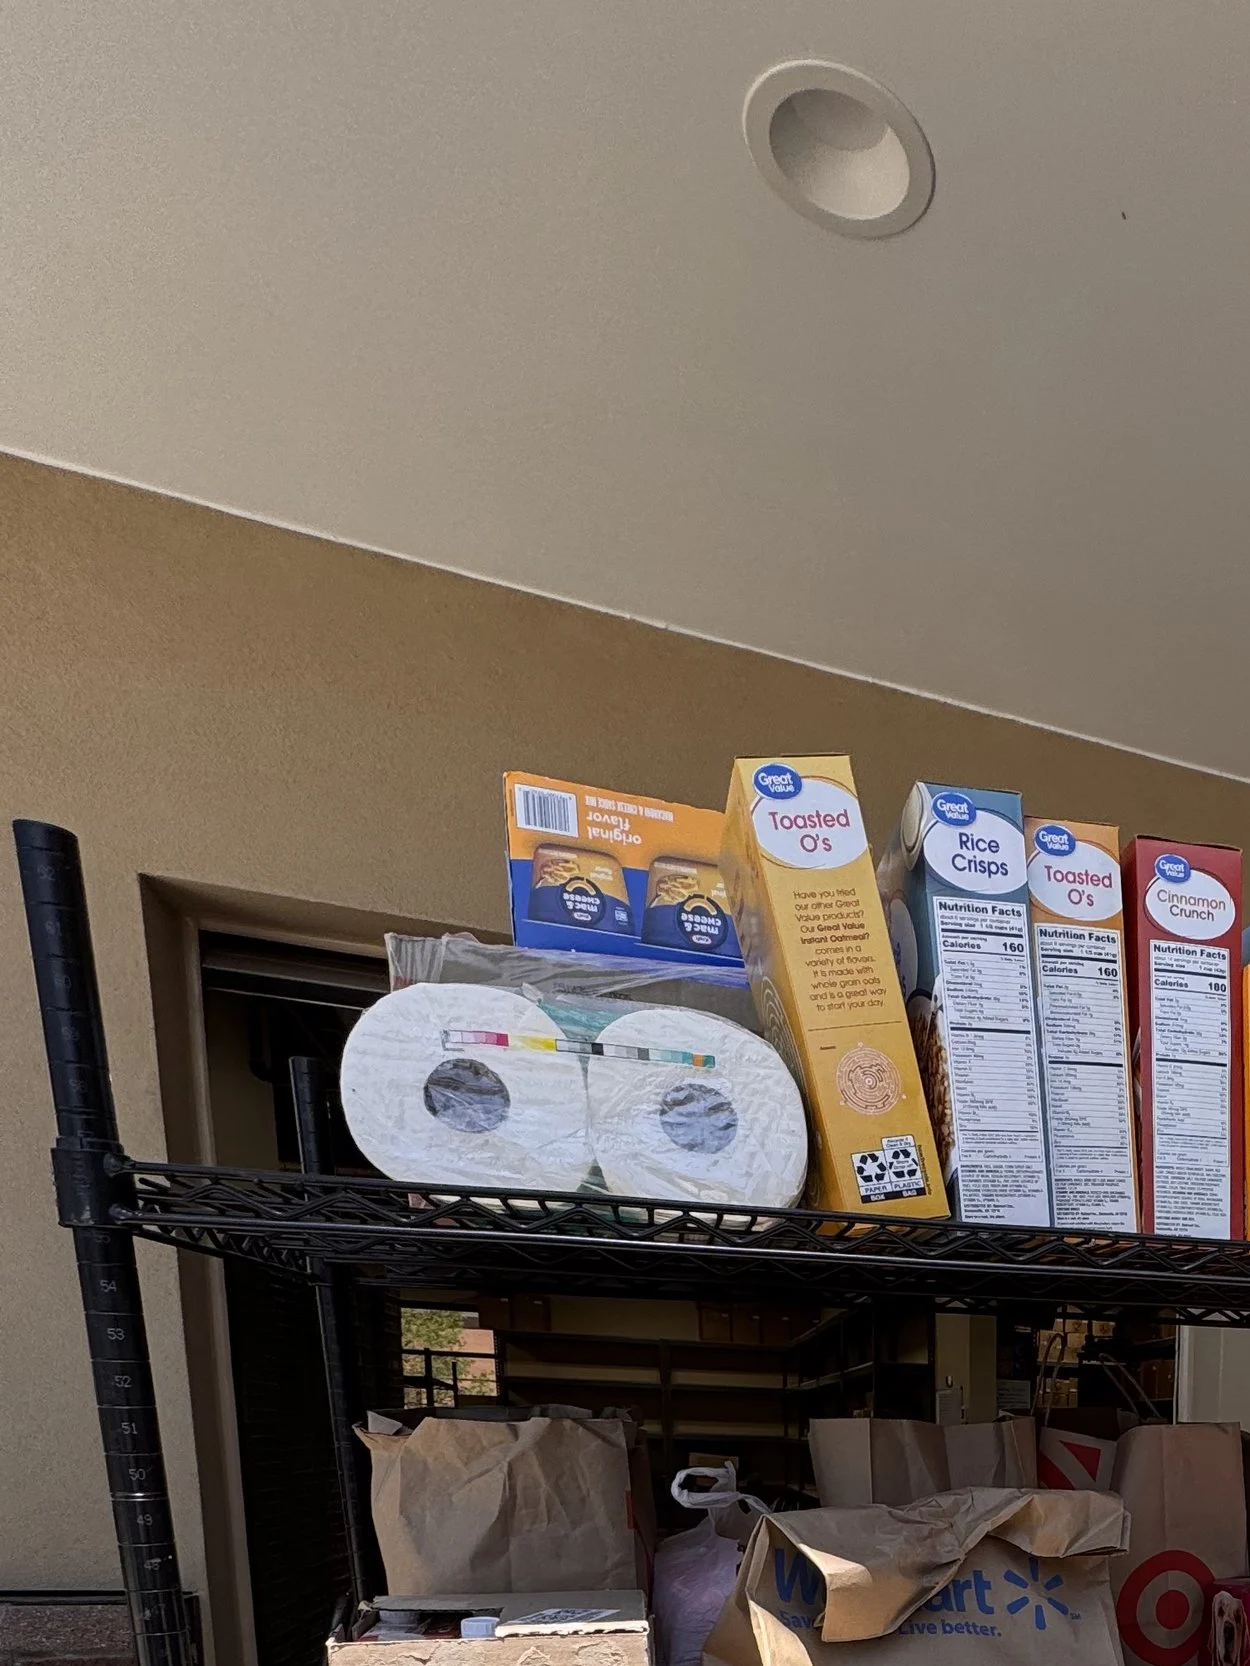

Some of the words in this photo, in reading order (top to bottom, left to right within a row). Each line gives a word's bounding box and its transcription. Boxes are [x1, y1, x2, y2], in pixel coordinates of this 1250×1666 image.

[758, 772, 793, 785] Great
[768, 783, 795, 793] Value
[937, 799, 969, 813] Great
[586, 812, 630, 831] flavor
[768, 808, 851, 831] Toasted
[945, 810, 969, 820] Value
[589, 826, 641, 845] original
[959, 832, 1000, 853] Rice
[1039, 830, 1069, 844] Great
[800, 833, 832, 853] O's
[1046, 842, 1070, 851] Value
[951, 854, 1009, 879] Crisps
[1159, 860, 1185, 872] Great
[1044, 865, 1113, 888] Toasted
[1068, 888, 1094, 907] O's
[1157, 889, 1226, 911] Cinnamon
[938, 901, 988, 915] Nutrition
[991, 905, 1022, 918] Facts
[1169, 904, 1215, 921] Crunch
[696, 922, 719, 935] mac
[1039, 928, 1086, 941] Nutrition
[1088, 932, 1116, 944] Facts
[942, 939, 982, 950] Calories
[1002, 941, 1024, 953] 160
[1153, 943, 1197, 958] Nutrition
[1200, 948, 1227, 960] Facts
[1042, 965, 1078, 975] Calories
[1097, 967, 1118, 978] 160
[1154, 978, 1189, 989] Calories
[100, 1279, 117, 1292] 54
[107, 1327, 125, 1341] 53
[115, 1375, 132, 1388] 52
[121, 1422, 137, 1435] 51
[128, 1468, 146, 1481] 50
[899, 1619, 938, 1637] Live
[942, 1620, 1002, 1637] better.
